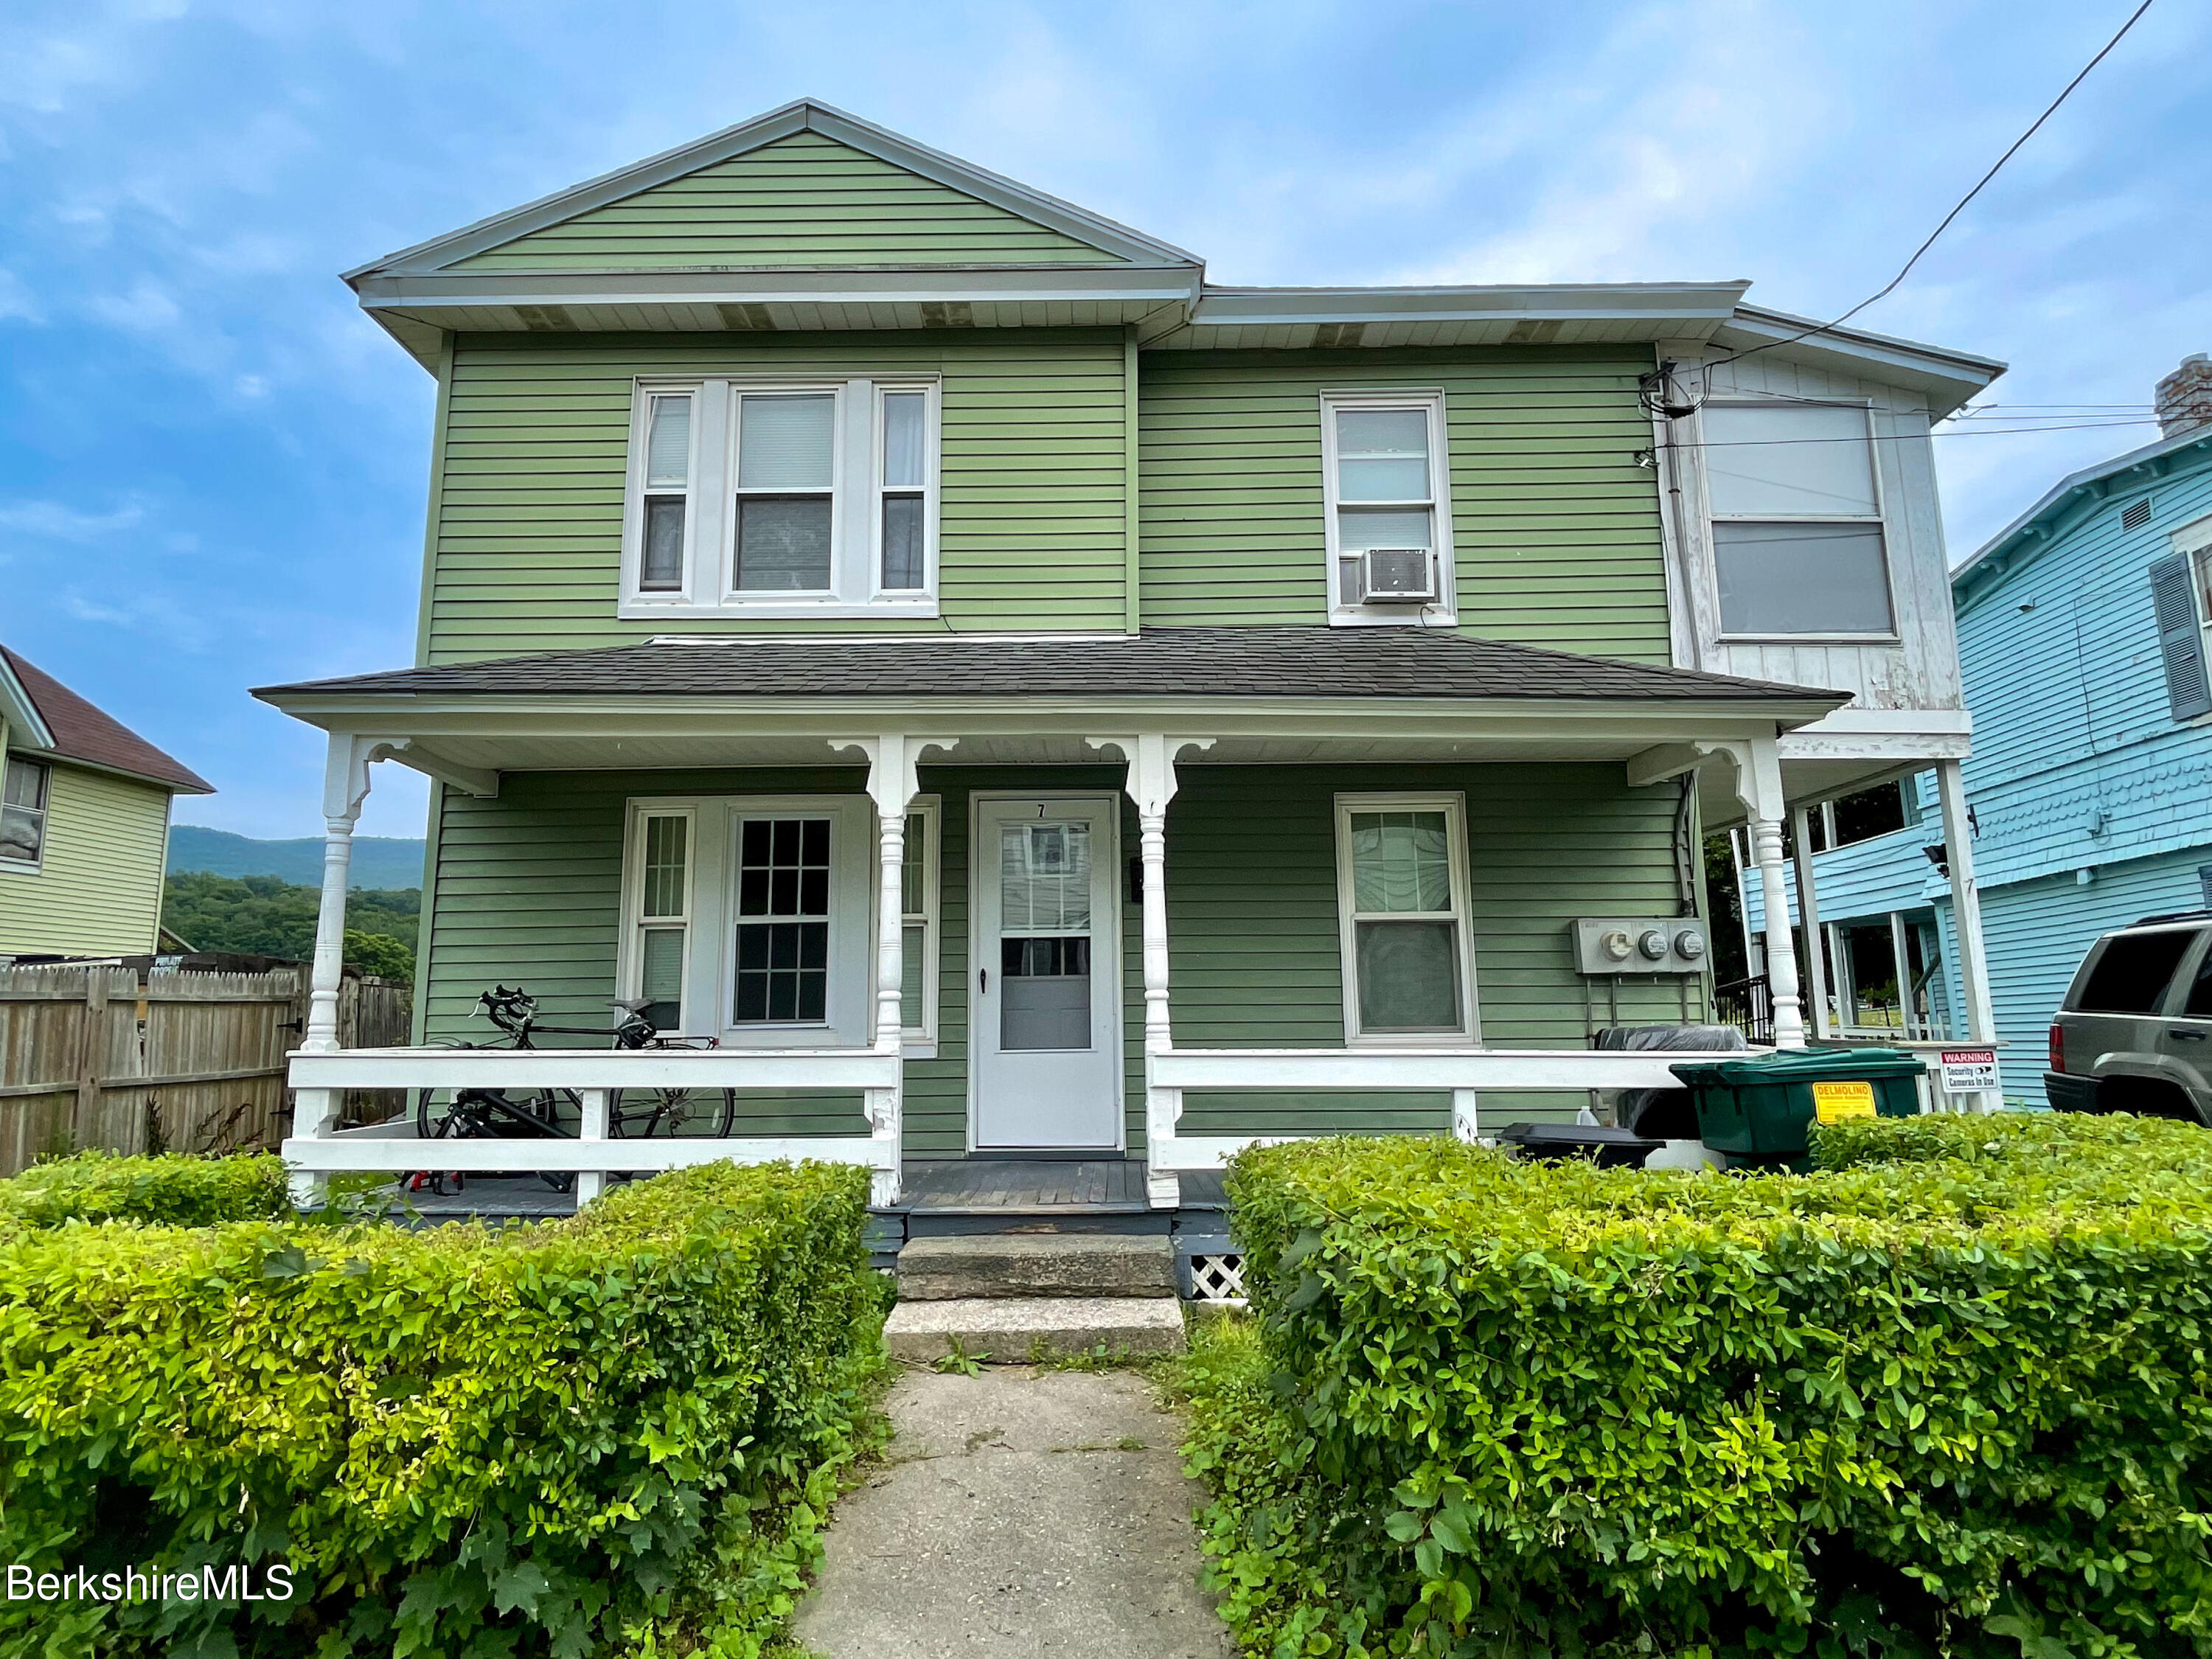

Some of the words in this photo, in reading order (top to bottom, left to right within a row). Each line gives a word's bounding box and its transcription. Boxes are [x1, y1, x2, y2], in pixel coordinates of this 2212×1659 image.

[1037, 804, 1045, 818] 7
[1944, 1052, 1992, 1062] WARNING
[1947, 1066, 1973, 1077] Security
[1949, 1078, 1975, 1087] Cameras
[1818, 1086, 1868, 1095] DELMOLINO
